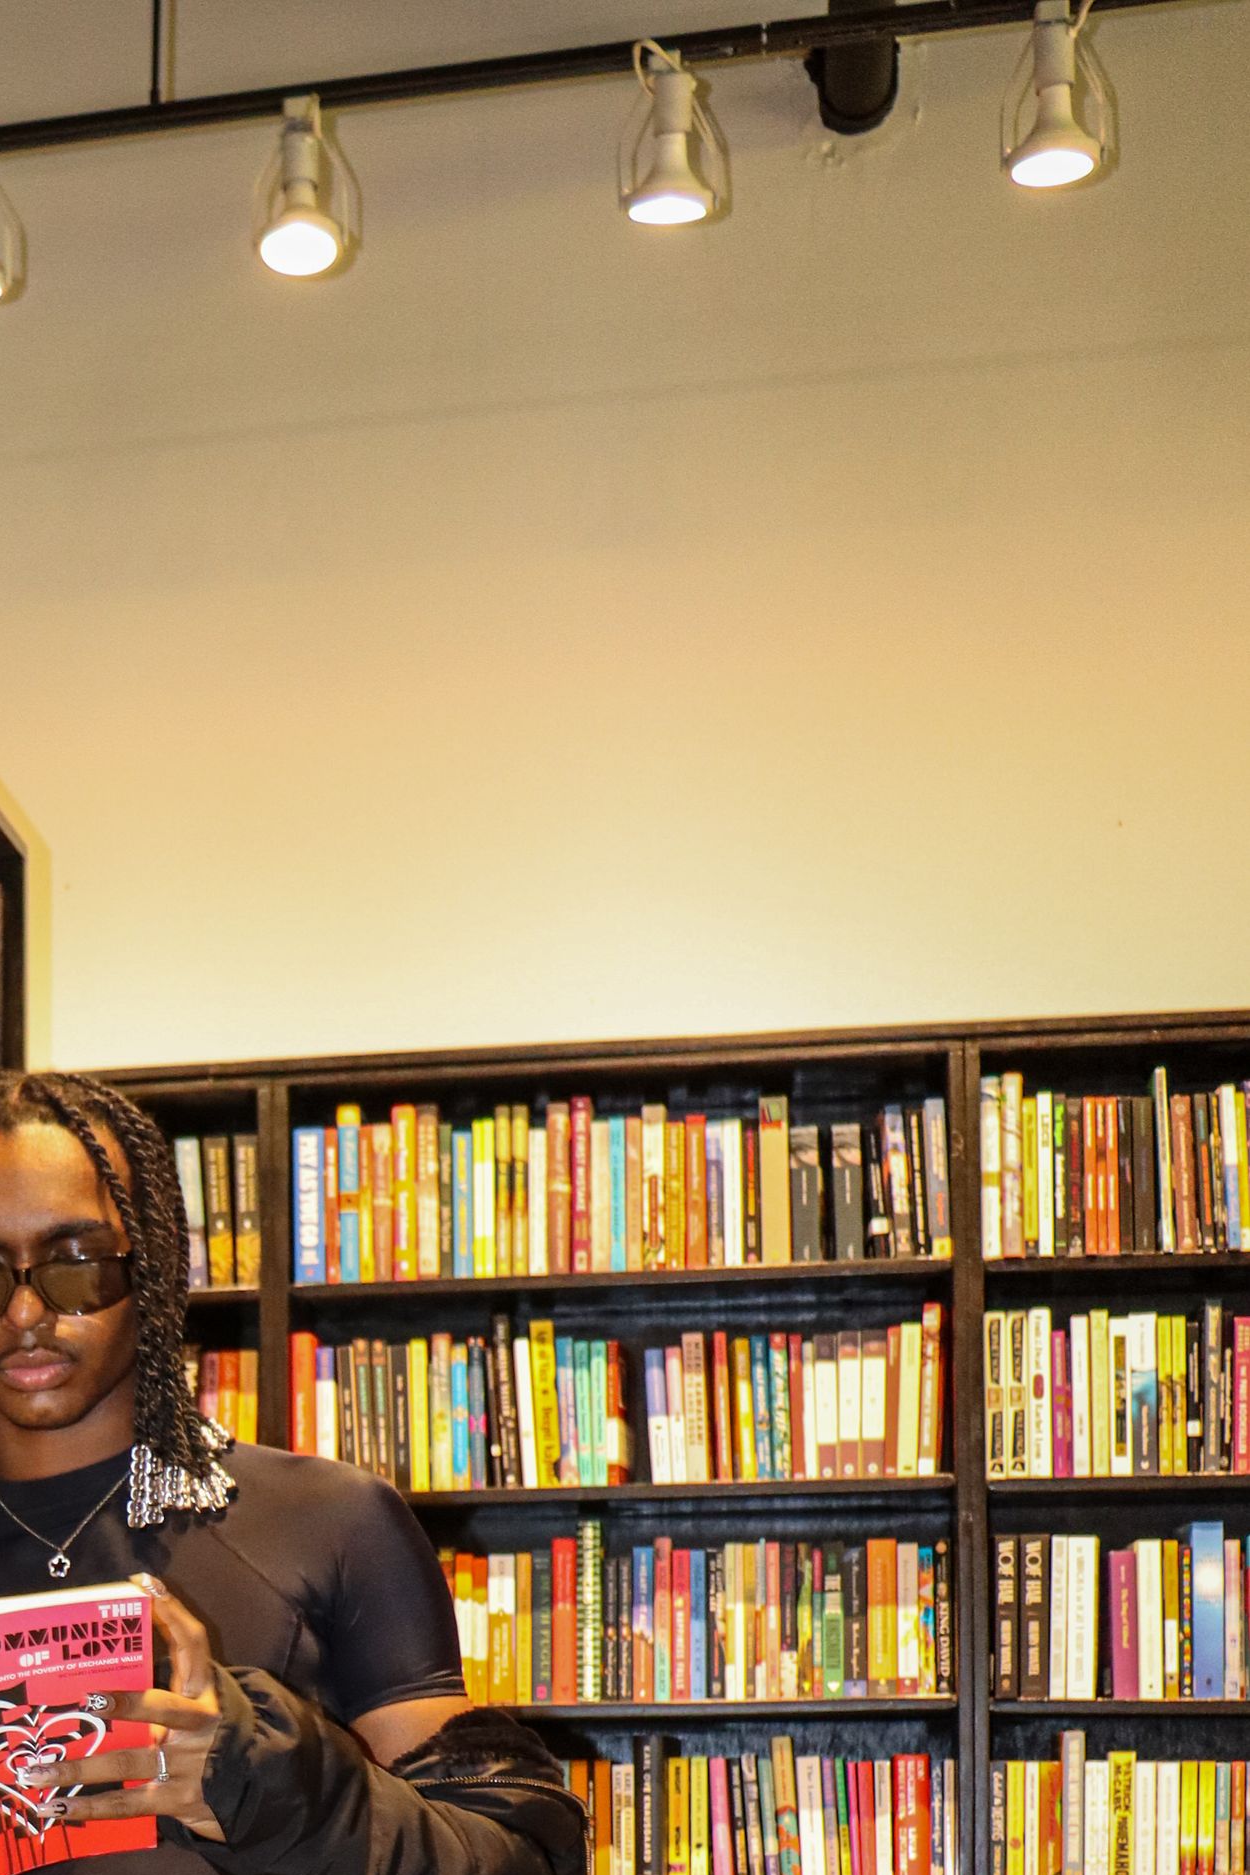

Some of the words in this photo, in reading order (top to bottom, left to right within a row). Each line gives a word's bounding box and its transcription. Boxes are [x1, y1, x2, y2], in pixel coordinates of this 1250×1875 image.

[98, 1602, 143, 1619] THE
[19, 1650, 50, 1667] OF
[62, 1636, 143, 1661] LOVE
[18, 1670, 32, 1679] THE
[32, 1665, 64, 1676] POVERTY
[66, 1661, 76, 1669] OF
[78, 1658, 119, 1668] EXCHANGE
[121, 1655, 143, 1663] VALUE
